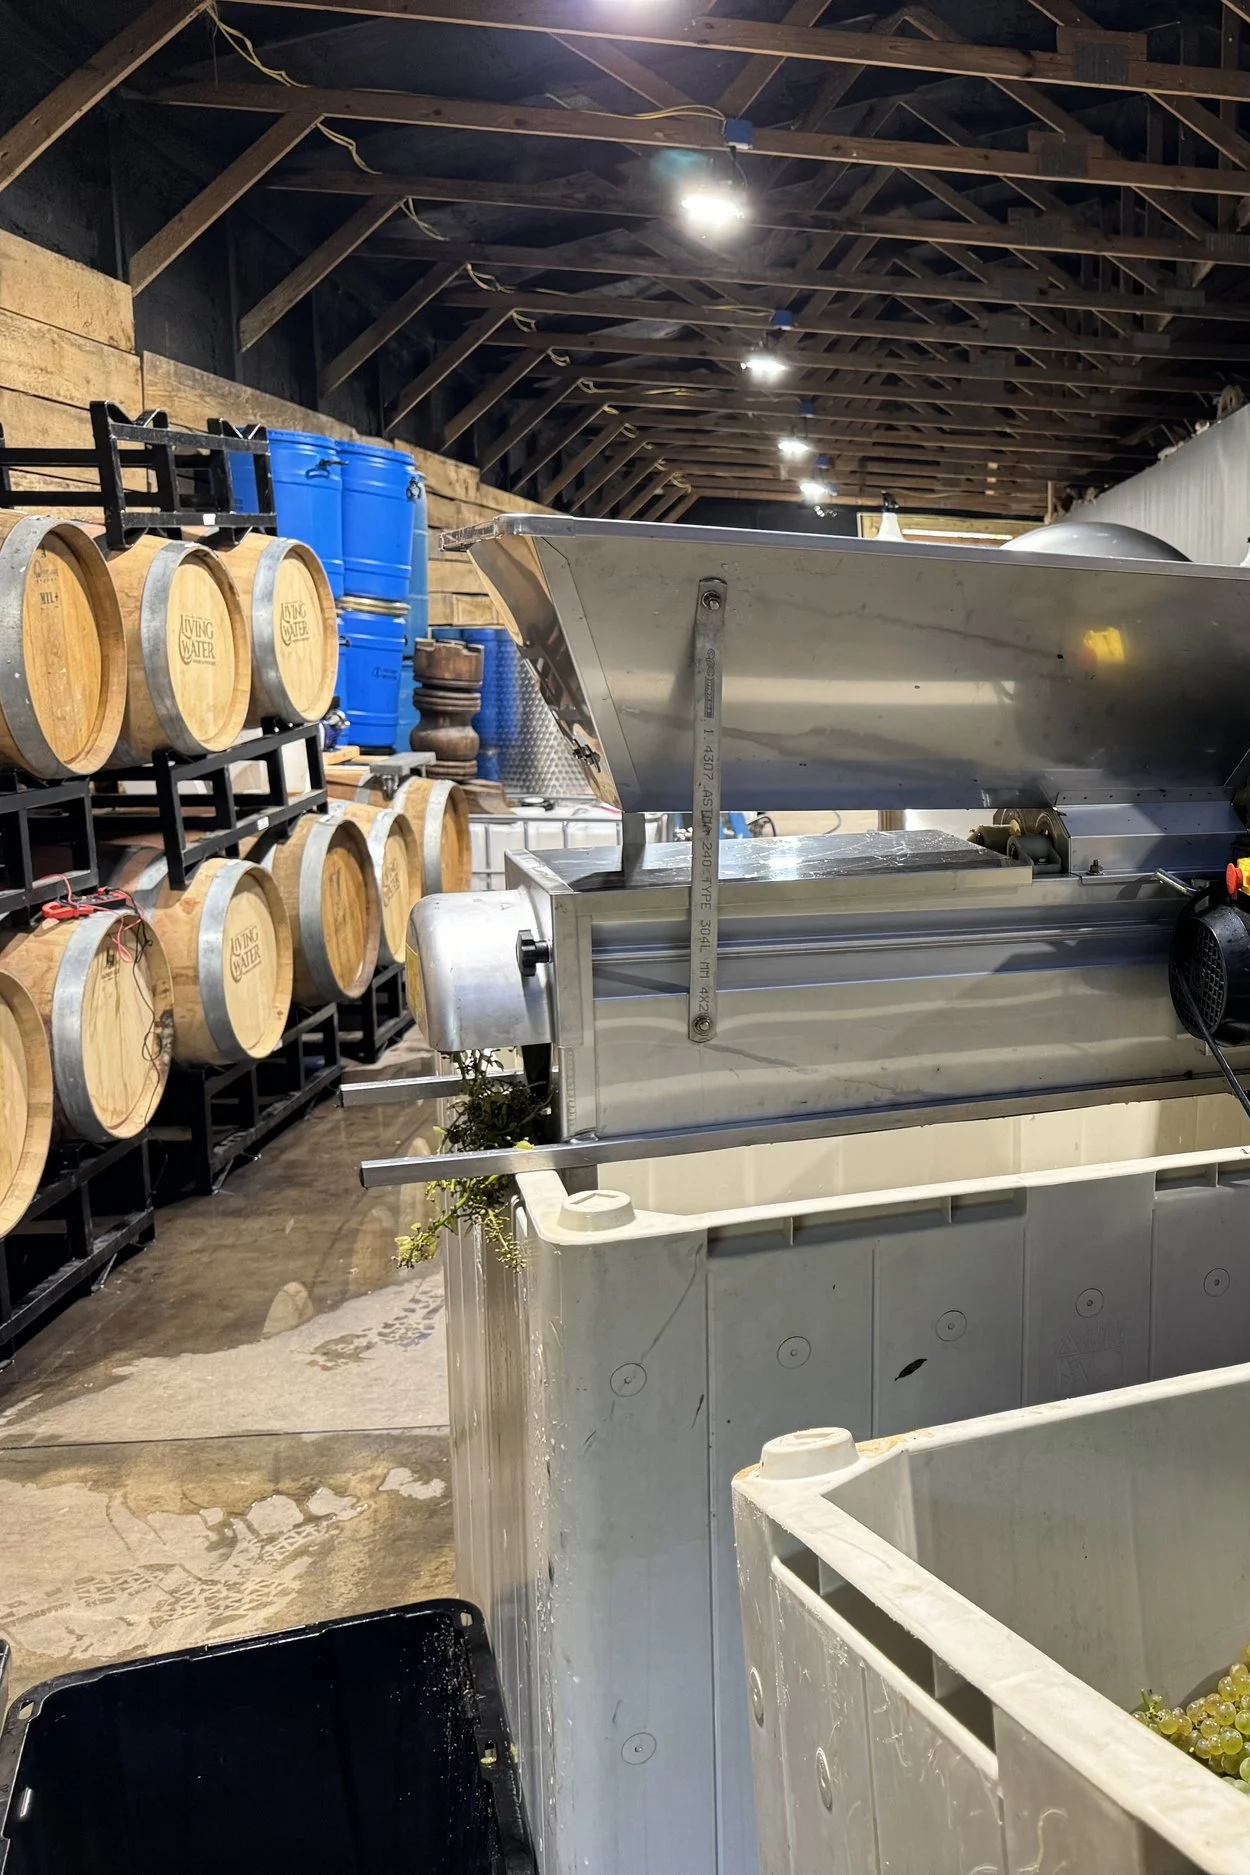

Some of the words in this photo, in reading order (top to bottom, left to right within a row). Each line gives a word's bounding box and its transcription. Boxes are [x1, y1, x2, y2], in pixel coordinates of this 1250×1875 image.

[280, 602, 308, 624] LIVING
[179, 614, 214, 640] LIVING
[282, 620, 309, 641] WATER
[181, 639, 216, 661] WATER
[702, 843, 713, 867] 240
[701, 877, 712, 910] TYPE
[230, 925, 259, 957] LIVING
[700, 920, 711, 952] 304L
[232, 943, 261, 973] WATER
[700, 961, 710, 979] MM
